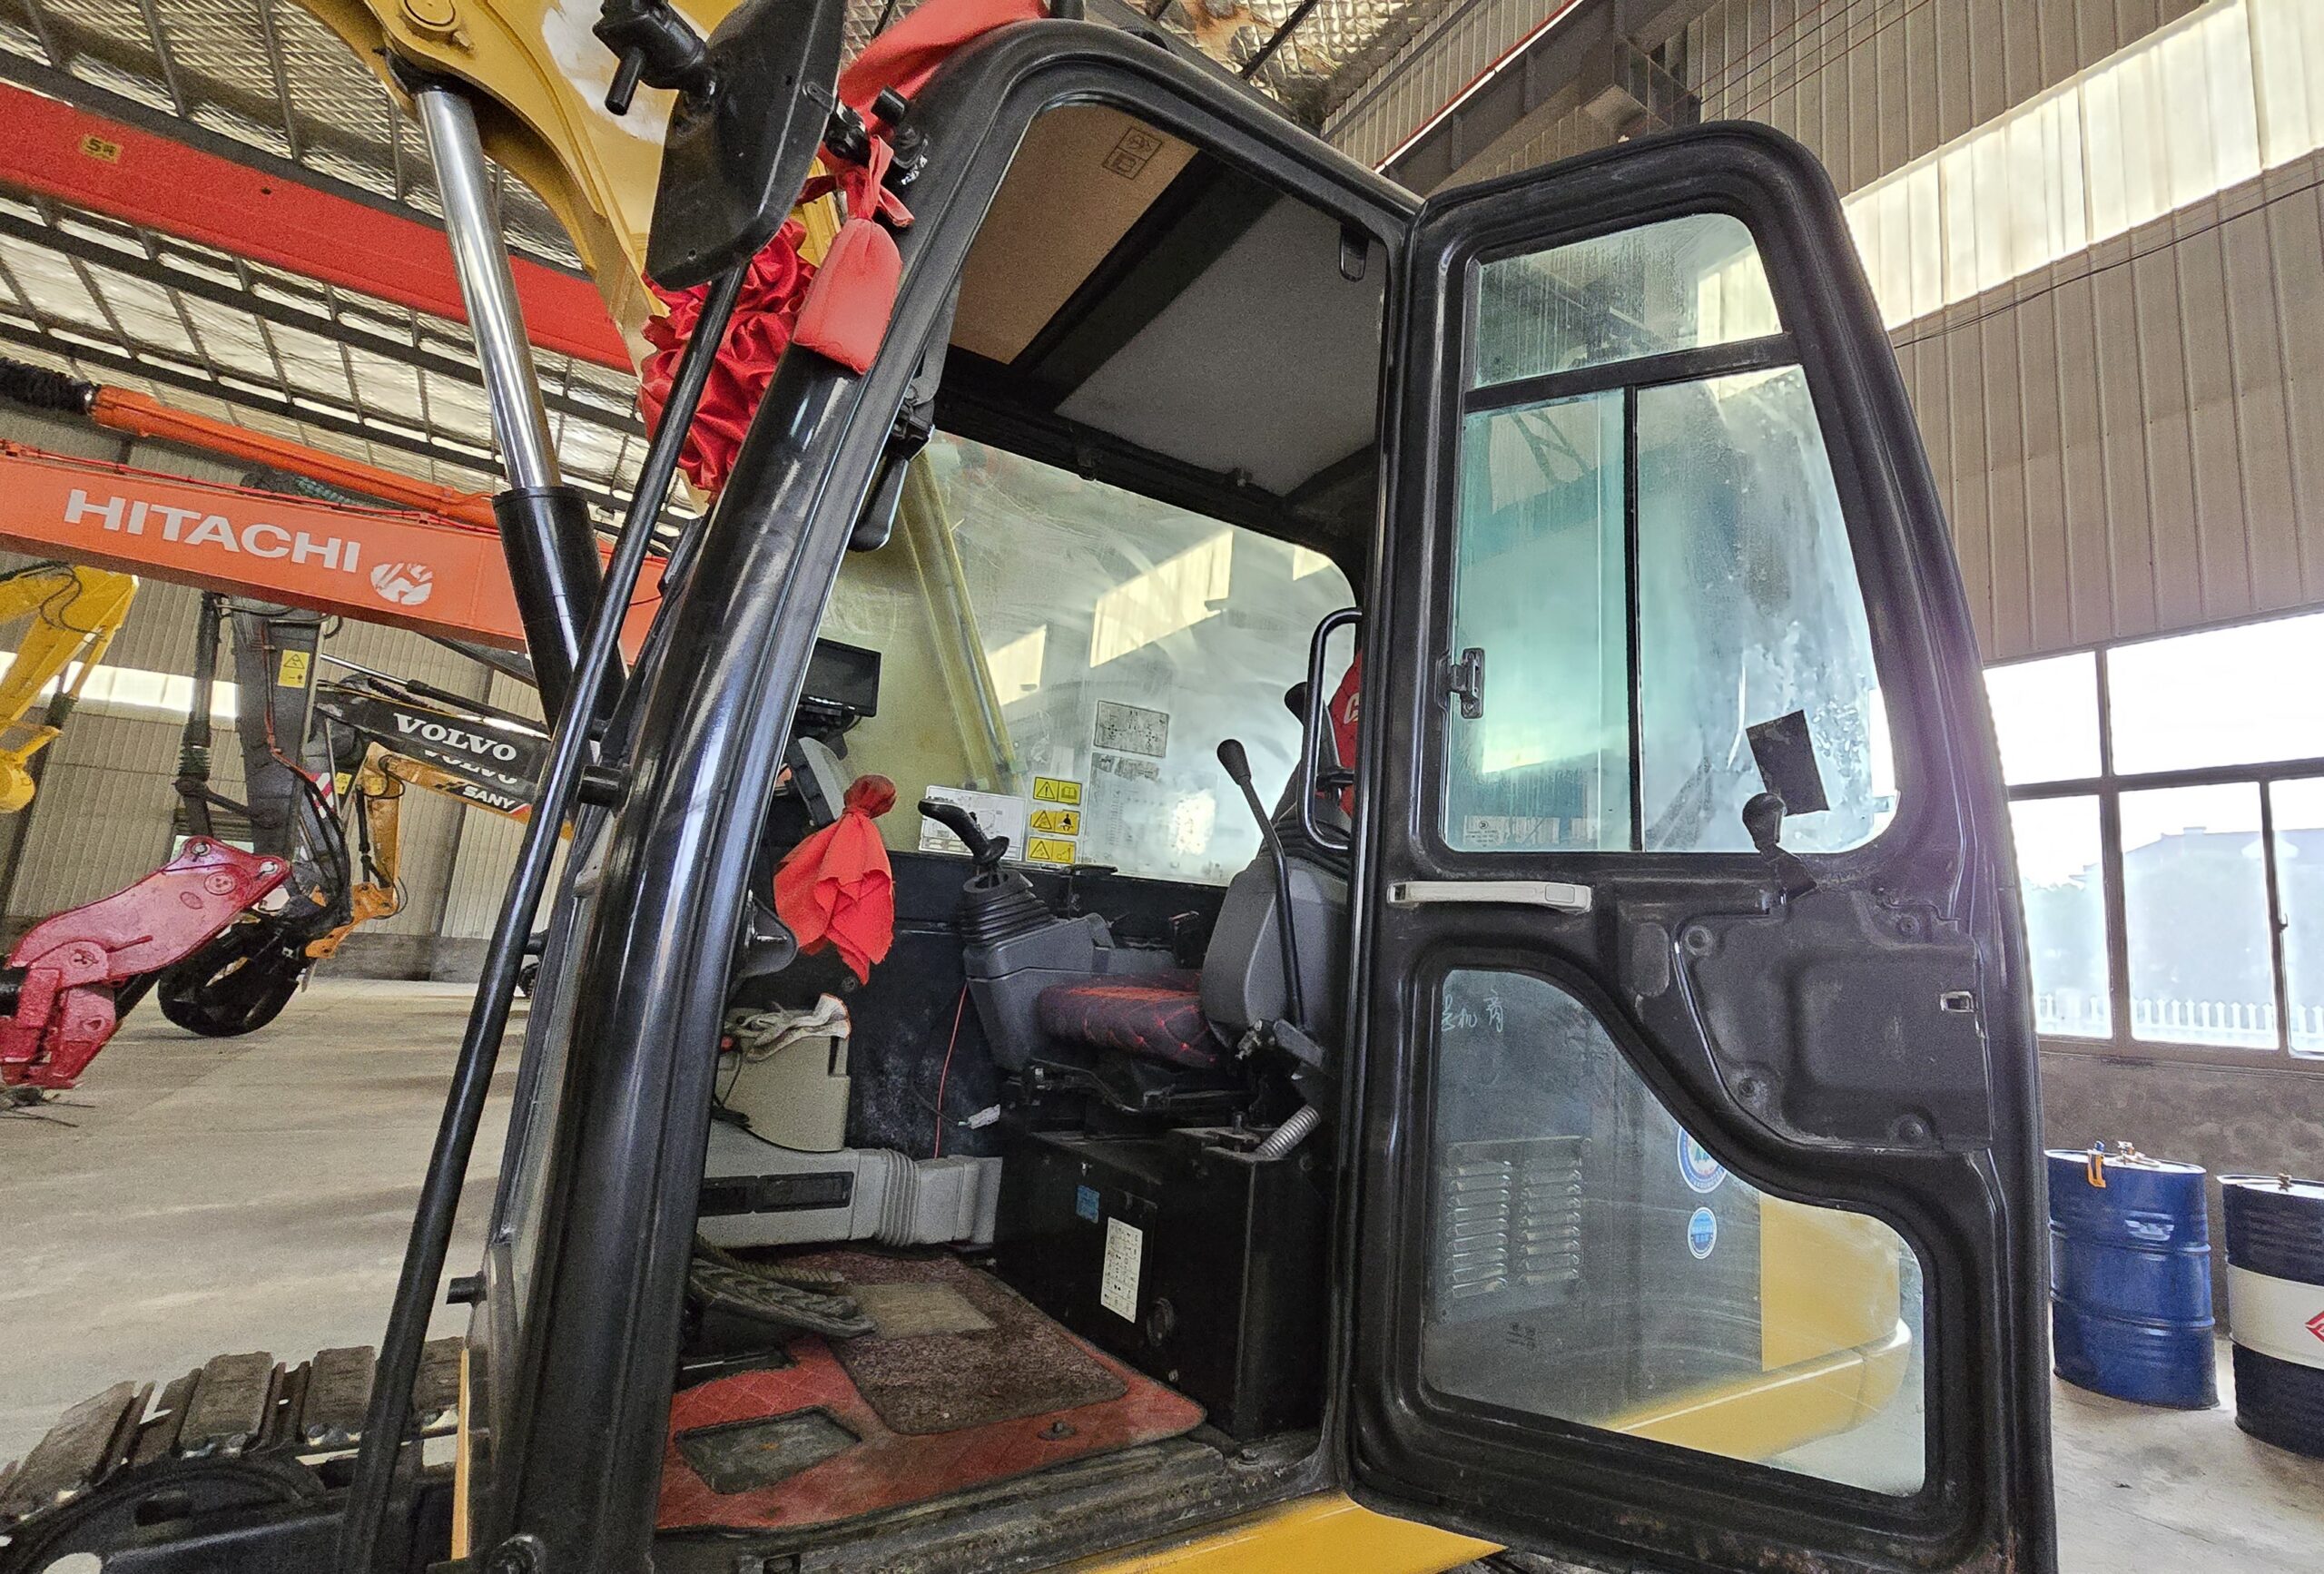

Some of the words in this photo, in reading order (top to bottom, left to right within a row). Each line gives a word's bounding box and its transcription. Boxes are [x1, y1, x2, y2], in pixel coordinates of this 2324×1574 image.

[64, 488, 361, 573] HITACHI
[393, 713, 517, 761] VOLVO
[463, 785, 516, 809] SANY
